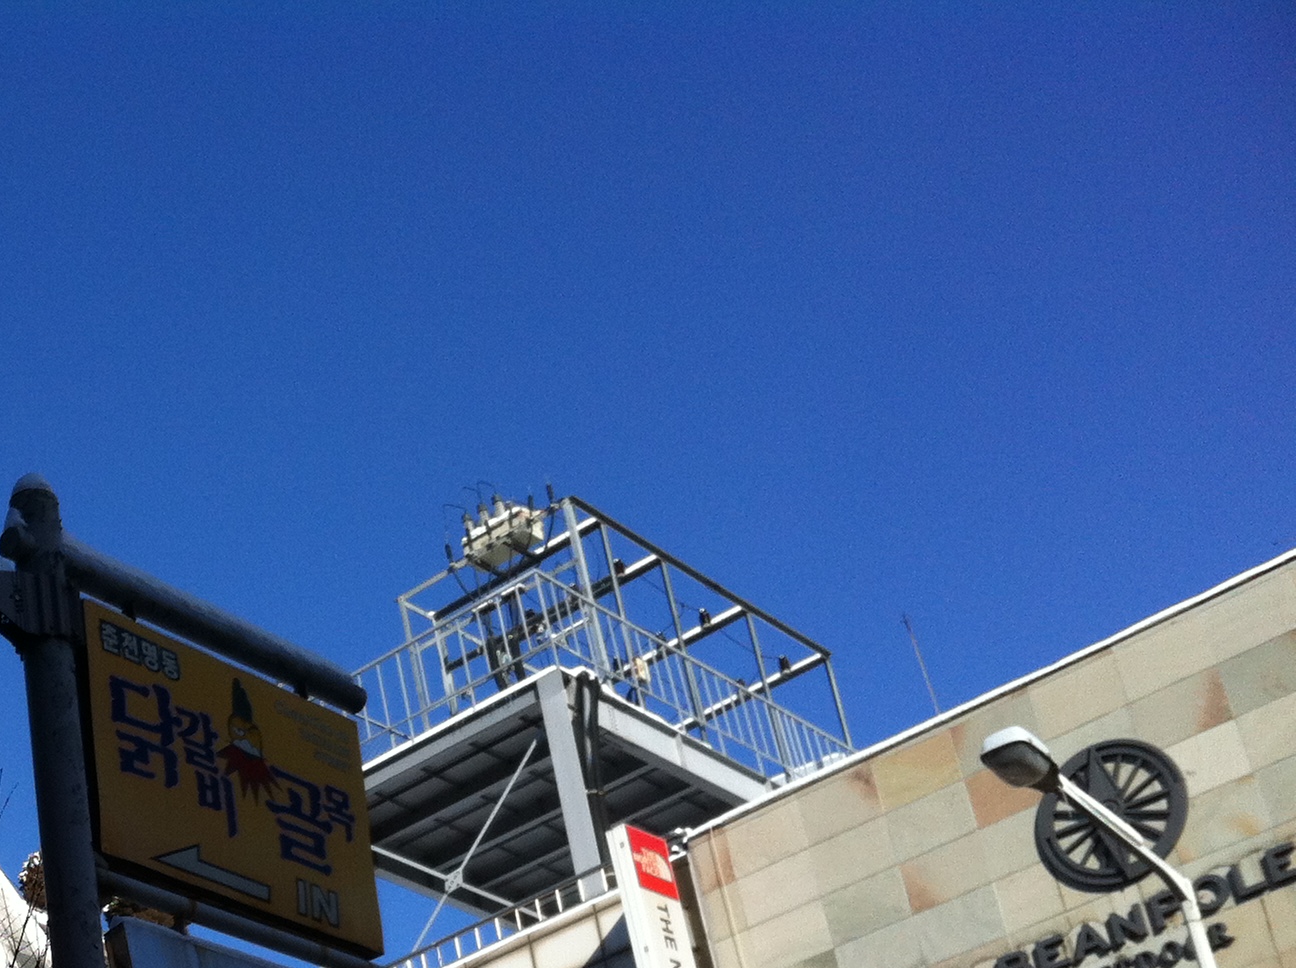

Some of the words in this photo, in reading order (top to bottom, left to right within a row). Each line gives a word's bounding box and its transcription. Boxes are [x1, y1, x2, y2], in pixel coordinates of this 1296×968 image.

[110, 675, 238, 837] 닭갈비
[266, 765, 355, 875] 골목
[296, 879, 340, 929] IN
[657, 905, 677, 952] THE
